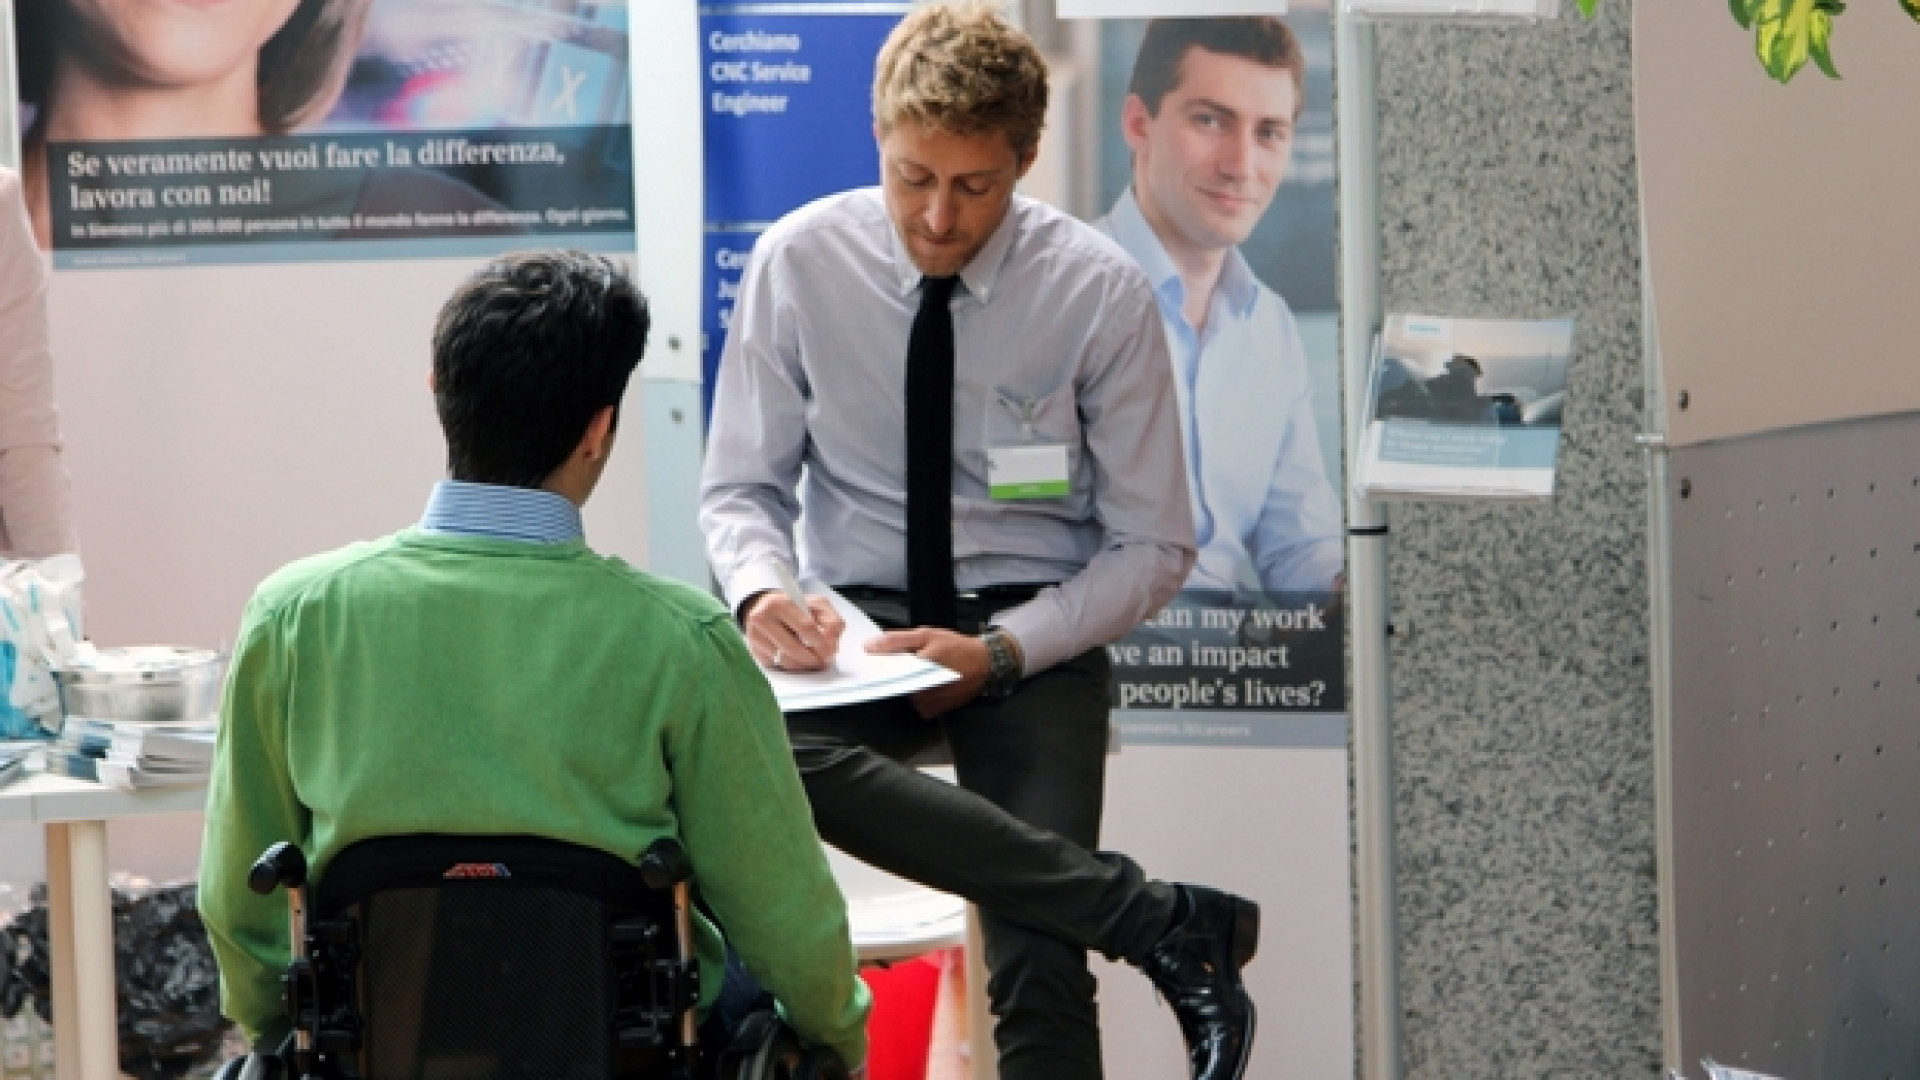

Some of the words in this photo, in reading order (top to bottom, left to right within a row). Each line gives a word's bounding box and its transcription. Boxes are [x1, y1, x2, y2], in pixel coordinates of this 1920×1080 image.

[709, 30, 802, 53] Cerchiamo
[710, 61, 748, 83] CNC
[752, 59, 811, 83] Service
[712, 91, 789, 117] Engineer
[68, 151, 100, 177] Se
[105, 148, 253, 176] veramente
[257, 142, 319, 170] vuoi
[325, 141, 380, 169] fare
[387, 139, 412, 167] la
[418, 138, 566, 166] differenza,
[70, 182, 156, 210] lavora
[160, 185, 212, 207] con
[217, 176, 271, 204] noi!
[1200, 609, 1246, 636] my
[1250, 602, 1327, 630] work
[1106, 645, 1141, 666] ve
[1149, 645, 1184, 666] an
[1191, 639, 1291, 674] impact
[1118, 677, 1238, 710] people's
[1244, 677, 1327, 706] lives?
